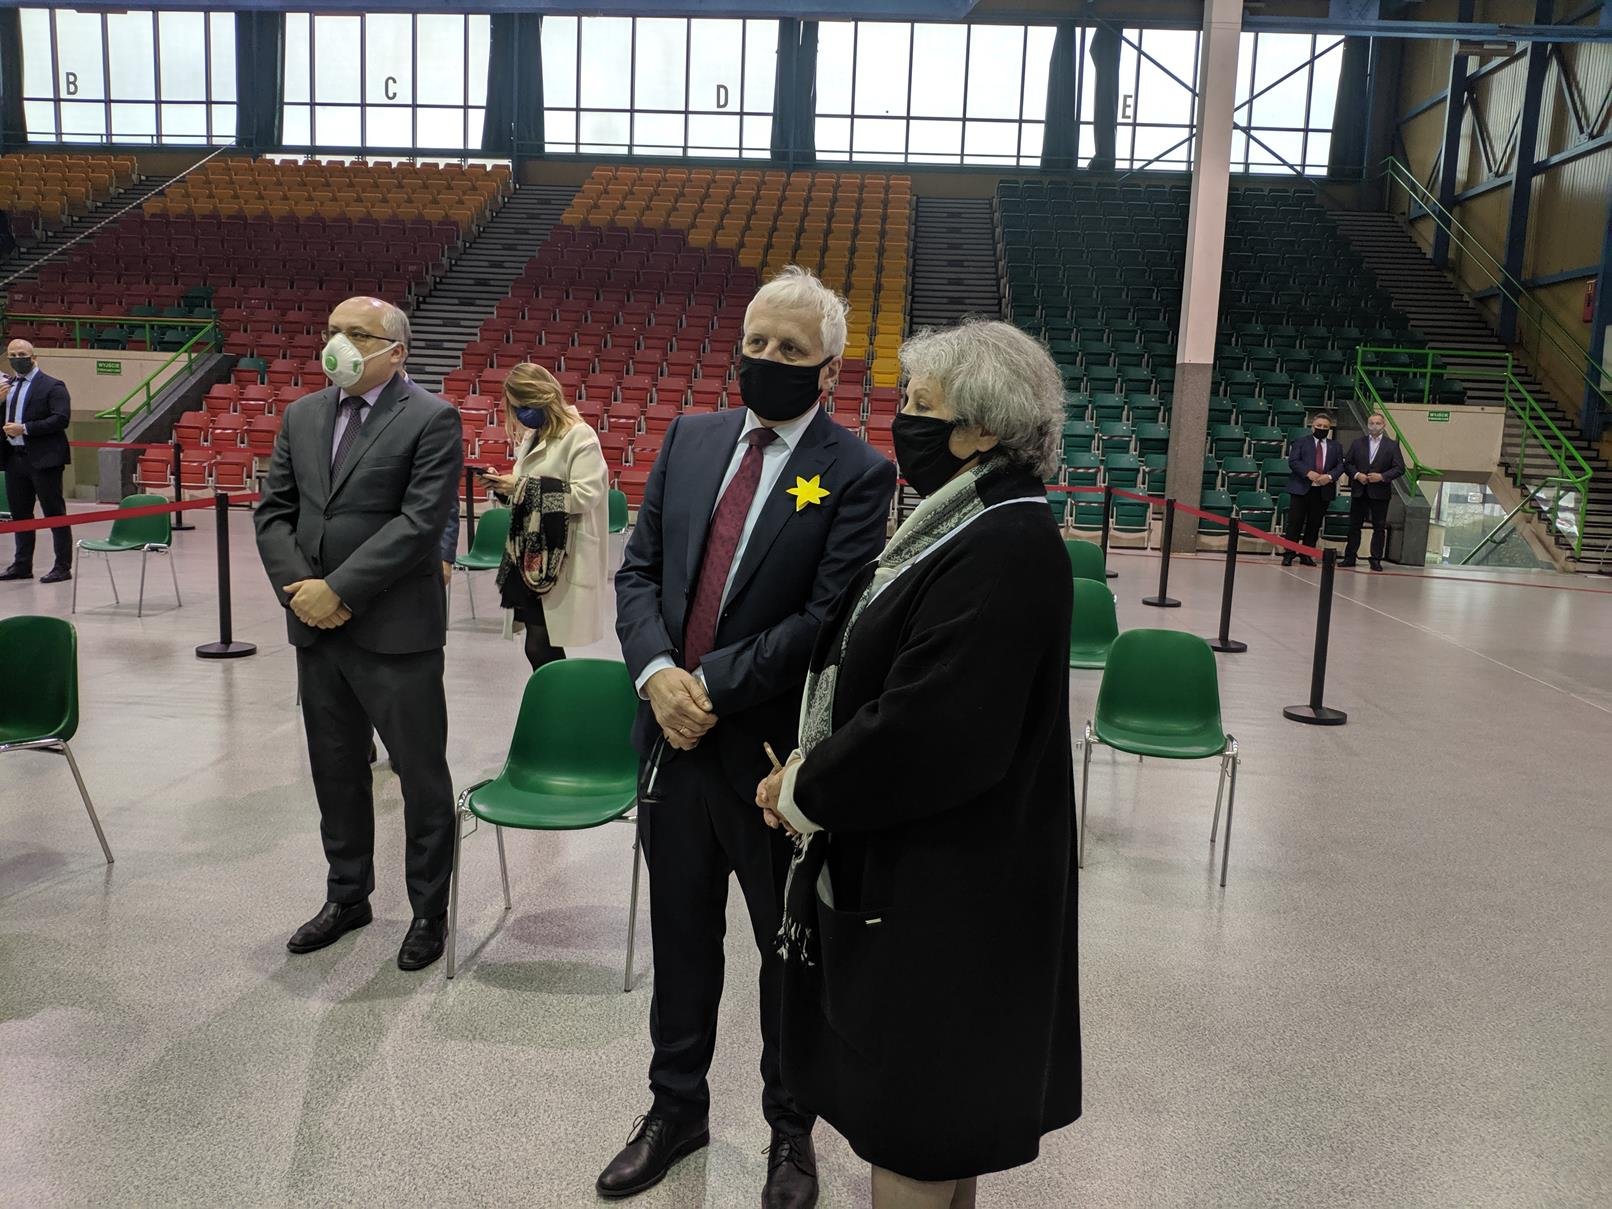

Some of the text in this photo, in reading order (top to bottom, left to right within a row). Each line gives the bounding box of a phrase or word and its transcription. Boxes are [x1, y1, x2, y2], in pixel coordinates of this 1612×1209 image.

[66, 72, 78, 95] B
[385, 77, 397, 100] C
[717, 85, 729, 108] D
[1121, 94, 1133, 119] E
